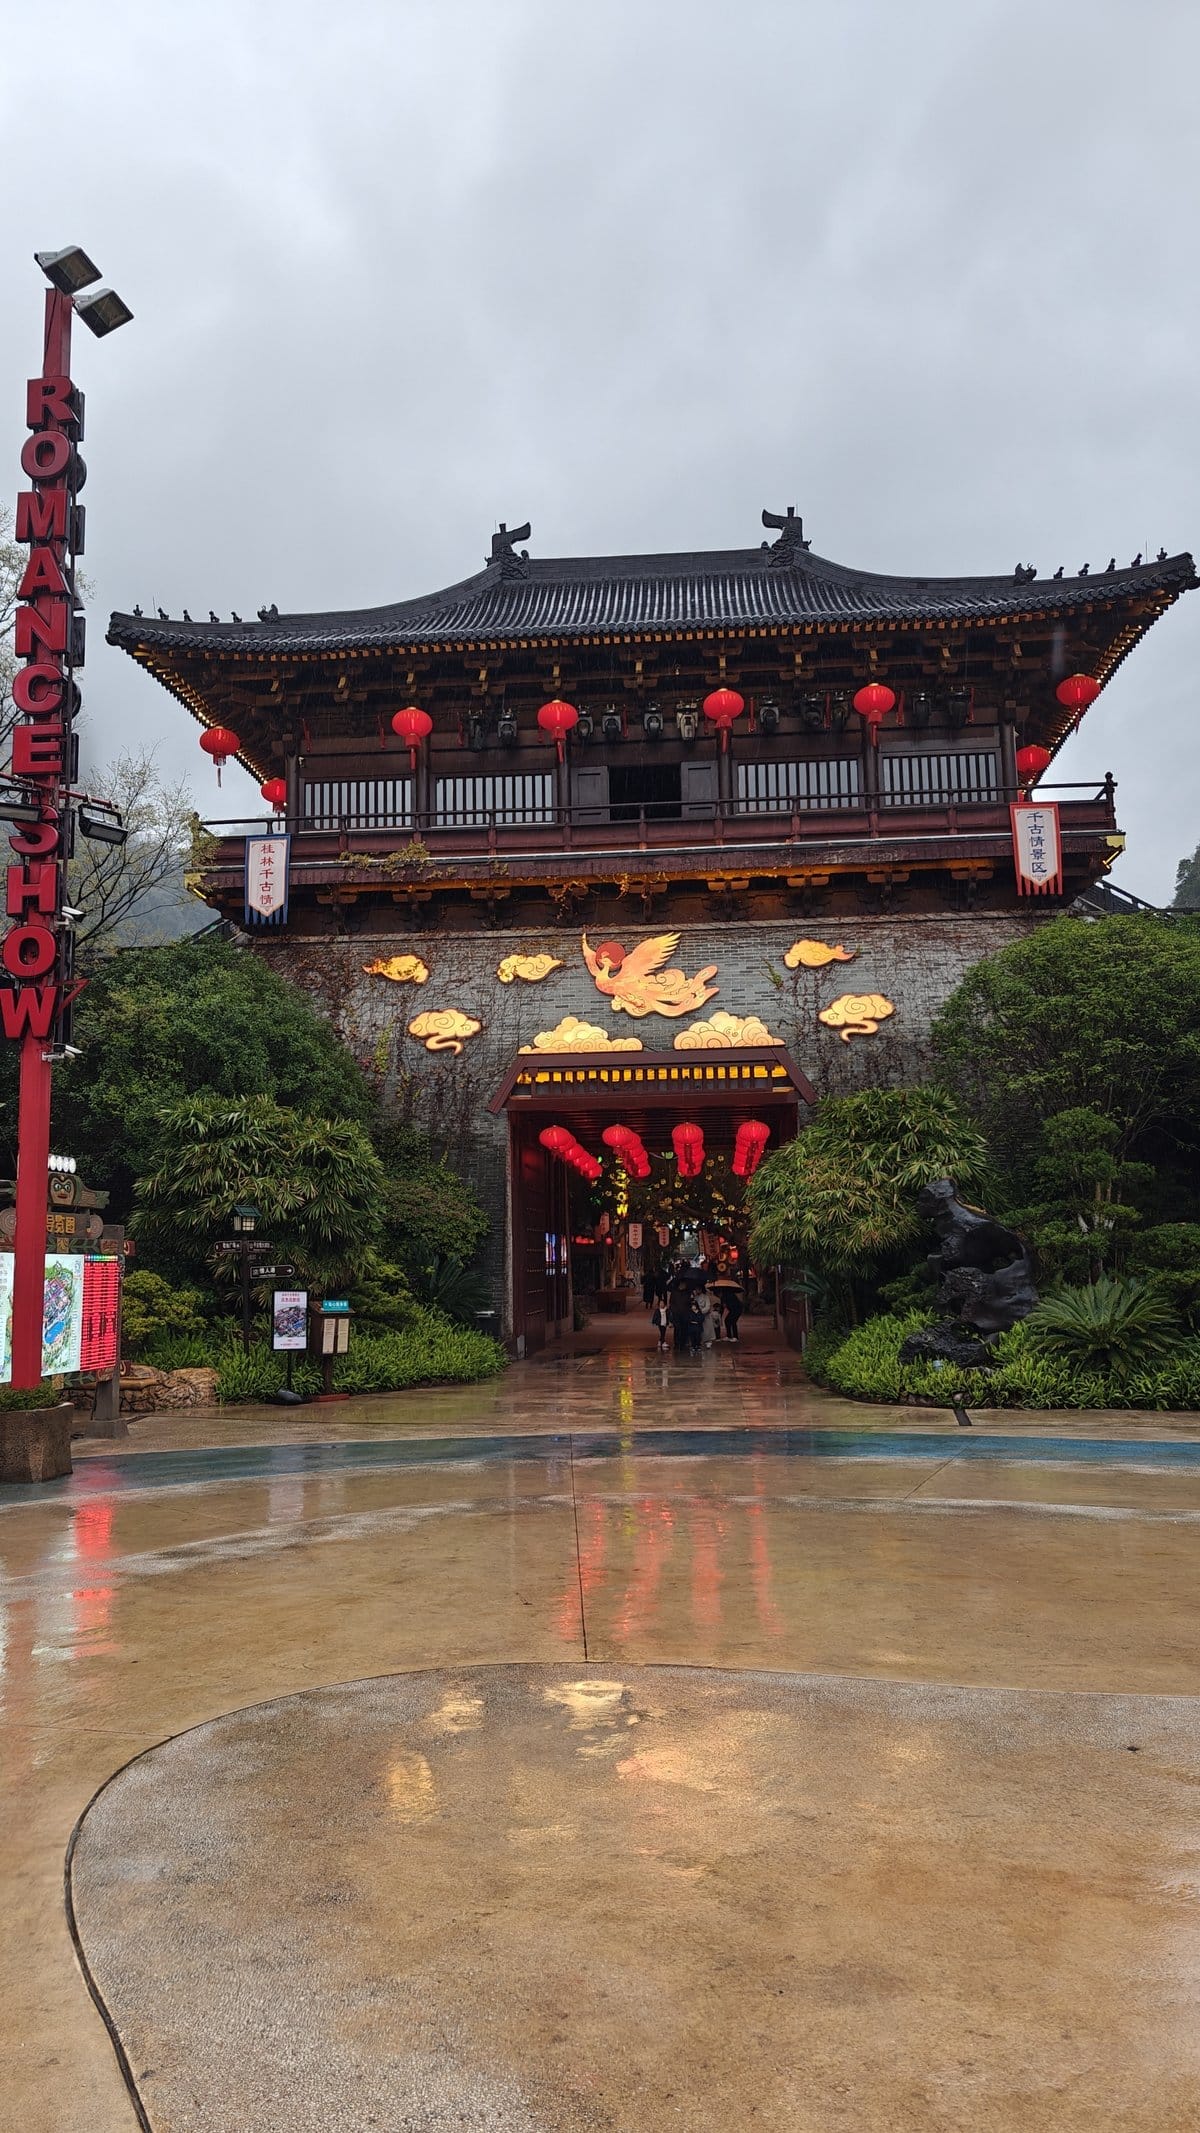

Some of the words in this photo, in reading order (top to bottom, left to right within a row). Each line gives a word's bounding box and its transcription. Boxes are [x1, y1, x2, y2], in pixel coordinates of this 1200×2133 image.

[12, 376, 78, 776] ROMANCE
[259, 843, 275, 905] 桂林千古情
[1026, 811, 1047, 873] 千古情景区
[0, 805, 59, 1040] SHOW
